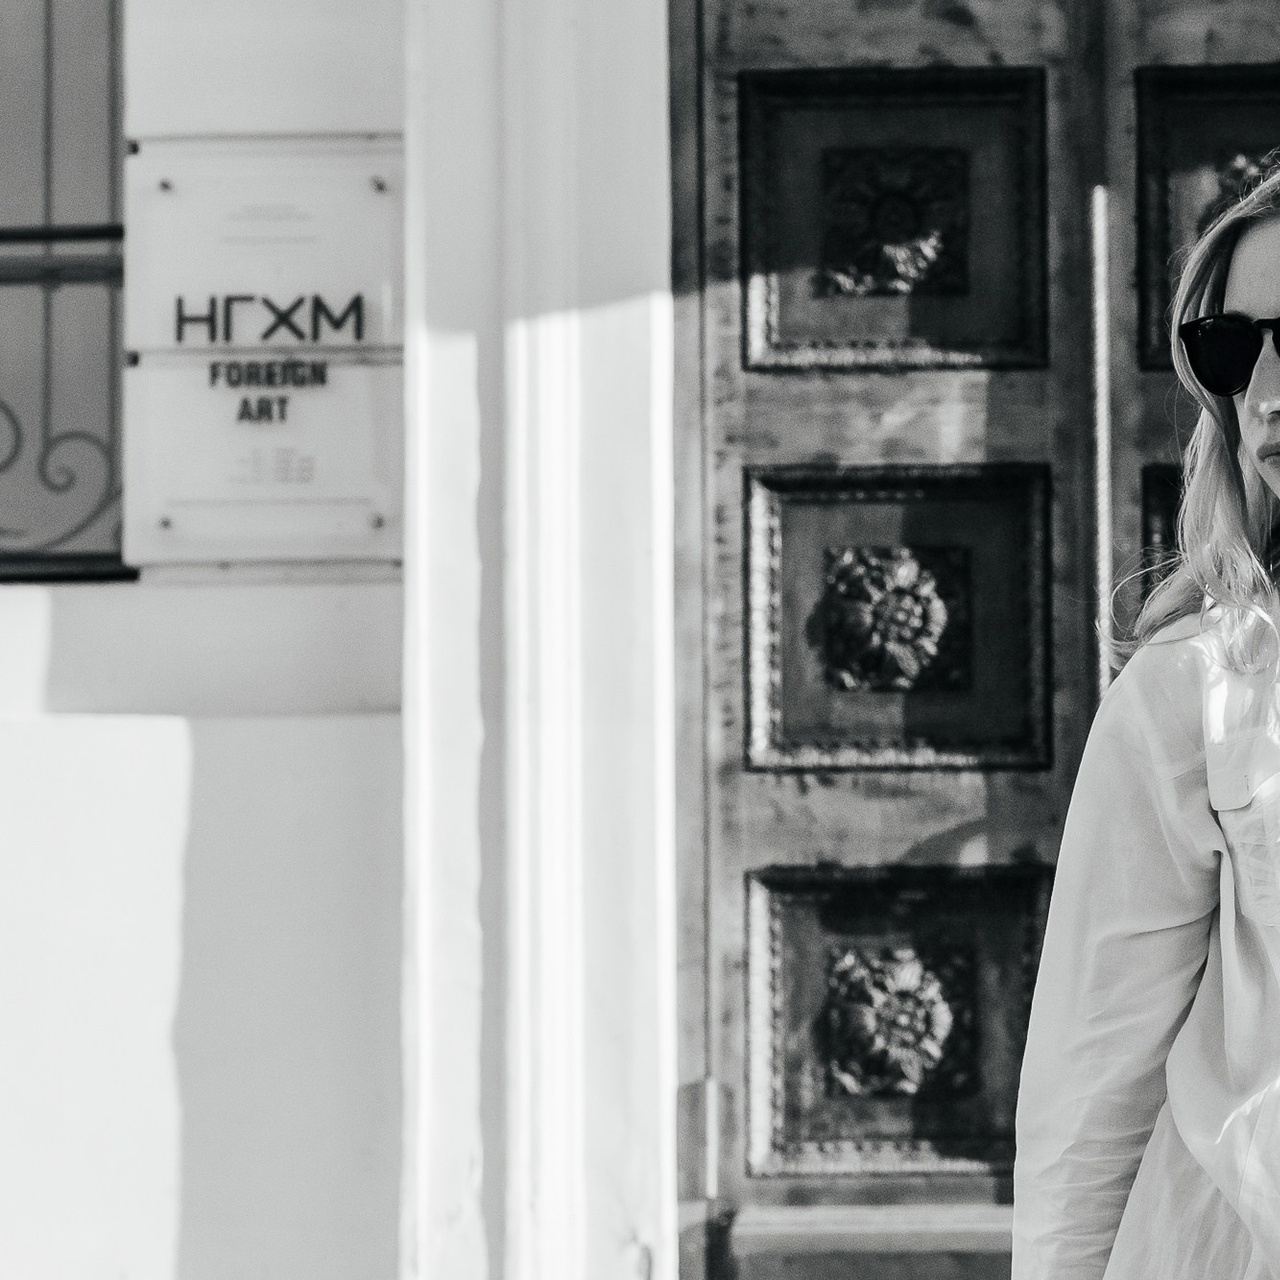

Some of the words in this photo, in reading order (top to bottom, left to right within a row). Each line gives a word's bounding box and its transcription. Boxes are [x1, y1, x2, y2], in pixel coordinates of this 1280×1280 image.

[175, 293, 364, 343] НГХМ
[208, 361, 328, 388] FOREIGN
[236, 396, 289, 423] ART
